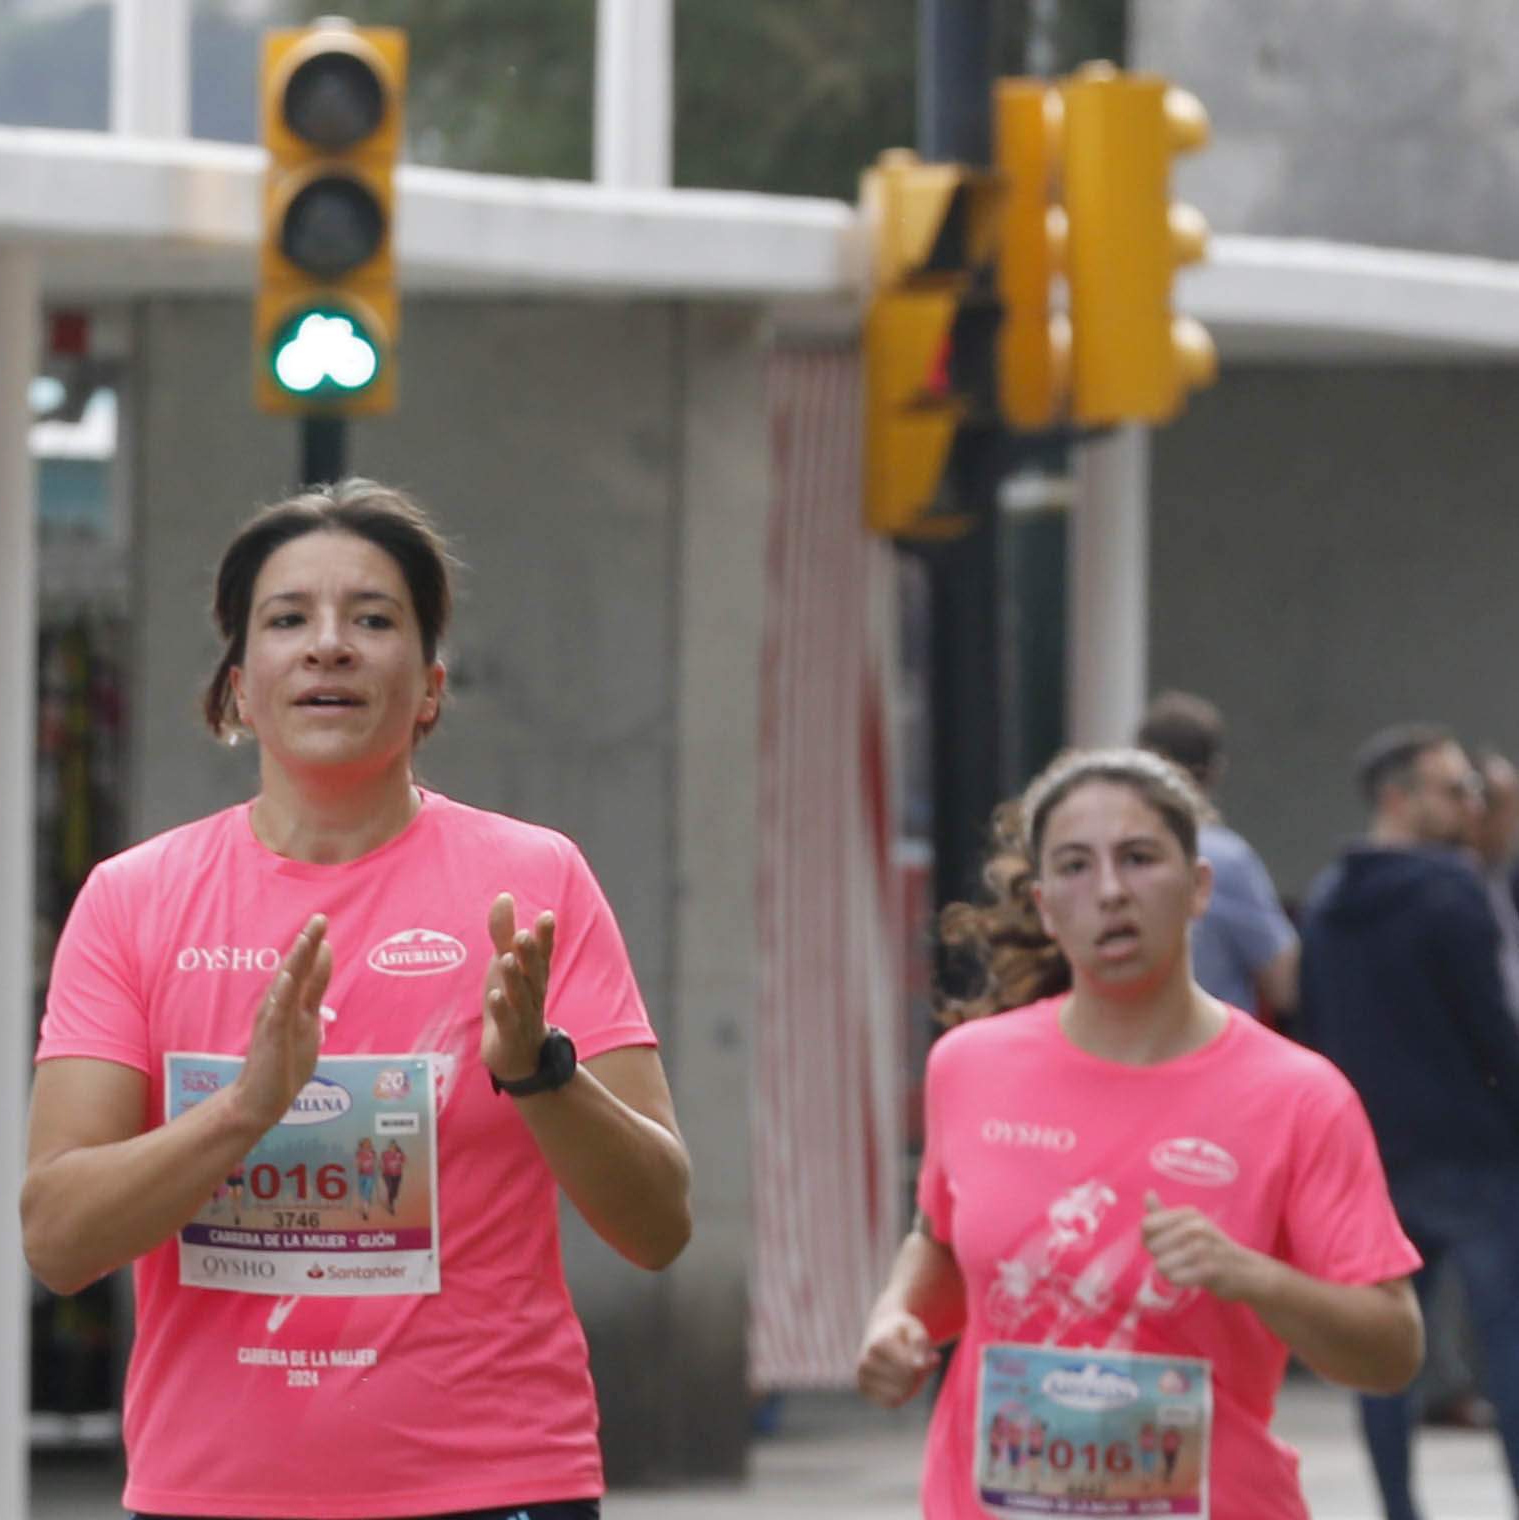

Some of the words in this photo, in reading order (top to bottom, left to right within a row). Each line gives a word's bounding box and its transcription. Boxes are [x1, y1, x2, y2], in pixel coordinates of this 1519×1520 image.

[177, 946, 281, 971] OYSHO
[292, 1096, 344, 1113] RIANA
[250, 1163, 348, 1201] 016
[274, 1211, 320, 1229] 3746
[202, 1254, 276, 1280] OYSHO
[327, 1263, 406, 1280] Santander
[1049, 1439, 1134, 1474] 016
